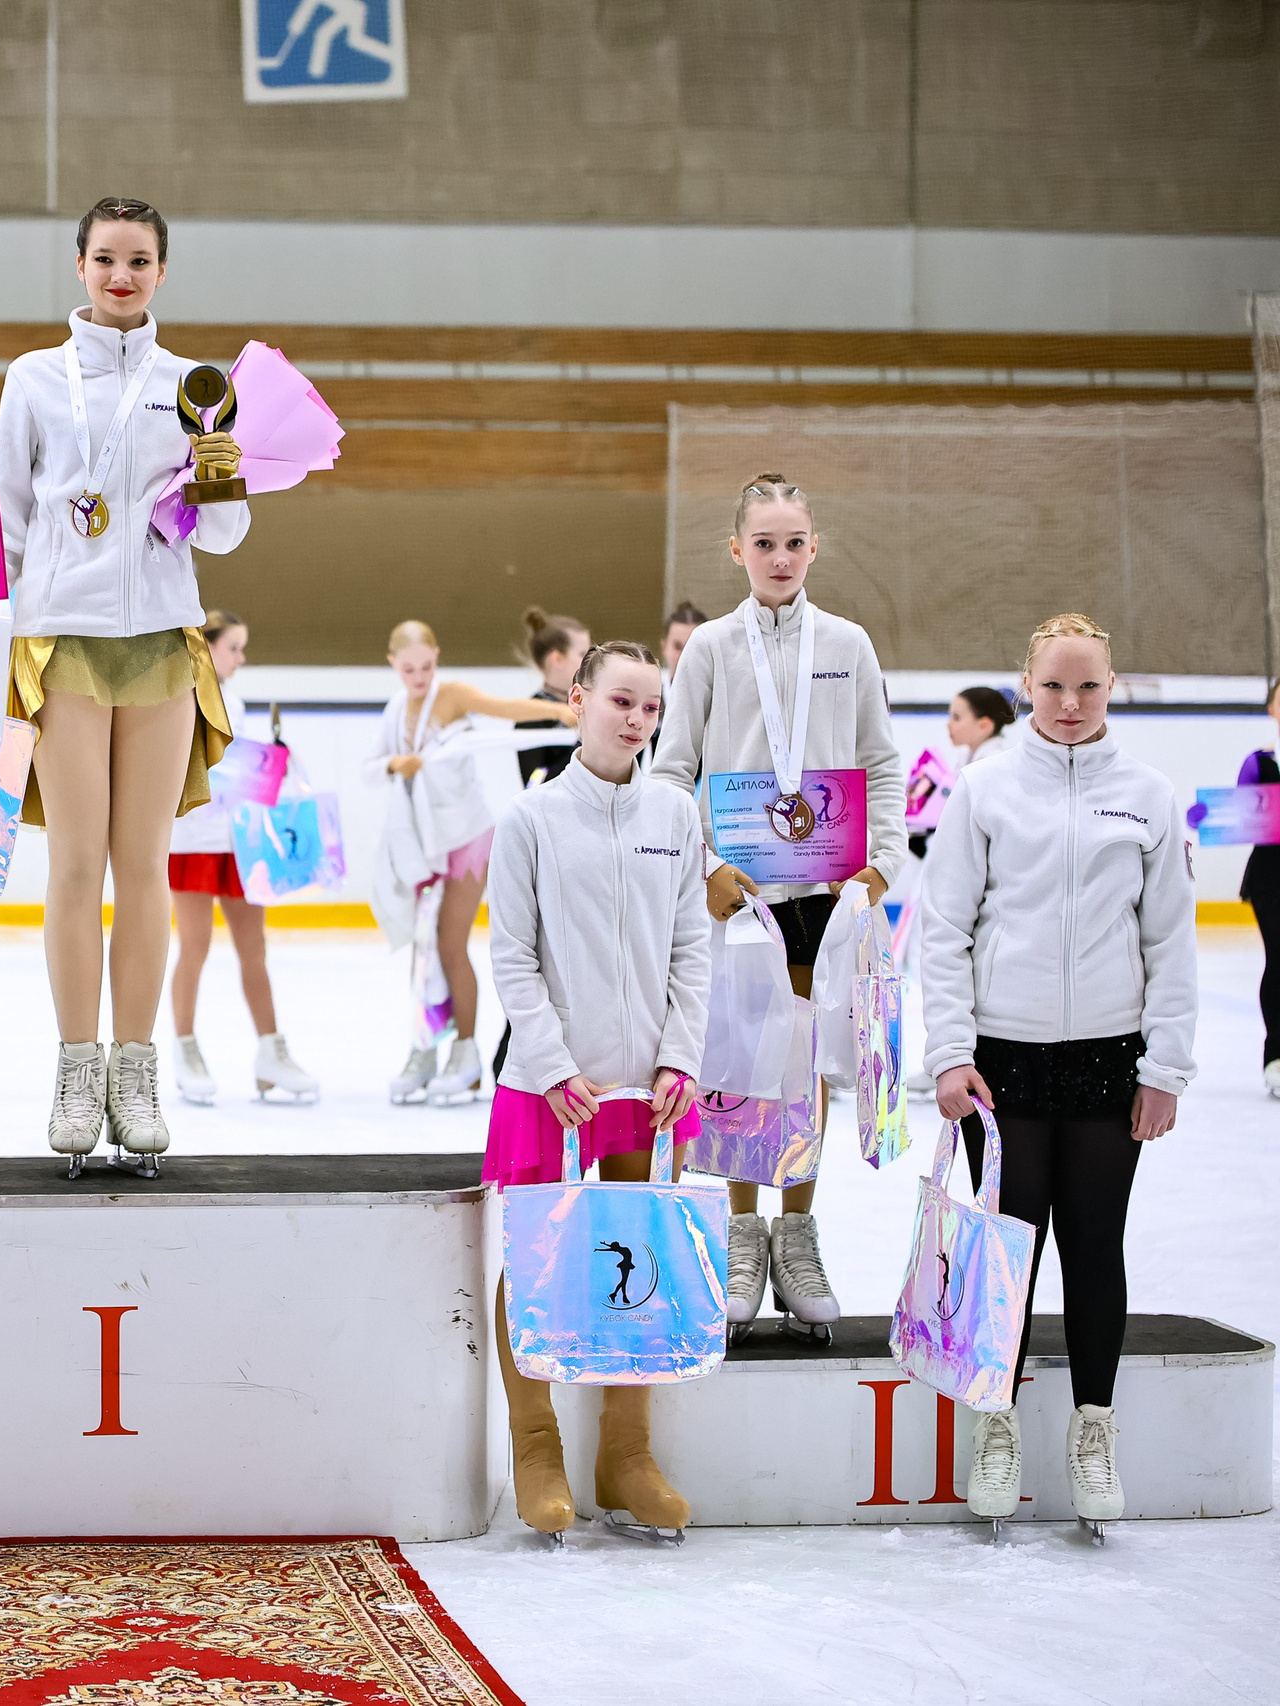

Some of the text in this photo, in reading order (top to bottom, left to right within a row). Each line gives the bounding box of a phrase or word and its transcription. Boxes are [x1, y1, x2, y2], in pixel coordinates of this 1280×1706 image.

[812, 671, 850, 679] ХАНГЕЛЬСК
[827, 811, 851, 829] CANDY
[600, 1314, 654, 1322] КУБОК CANDY
[83, 1306, 138, 1436] I
[856, 1377, 1034, 1506] II
